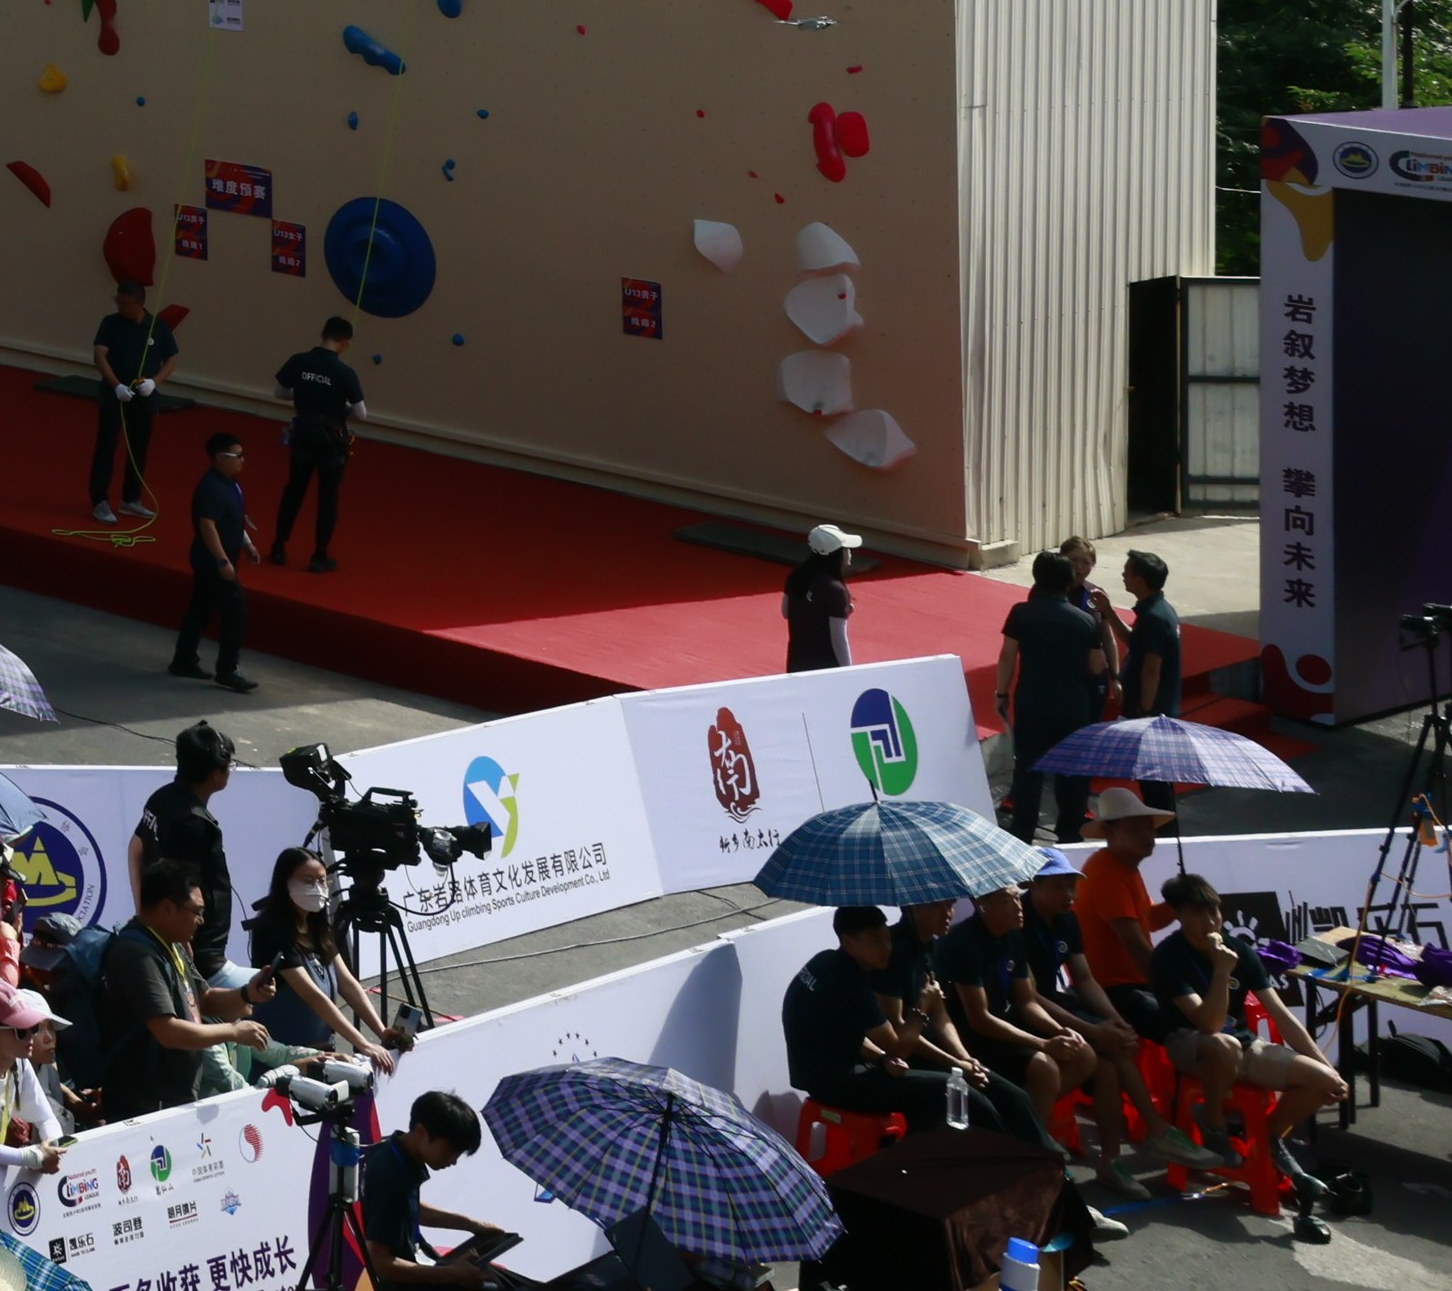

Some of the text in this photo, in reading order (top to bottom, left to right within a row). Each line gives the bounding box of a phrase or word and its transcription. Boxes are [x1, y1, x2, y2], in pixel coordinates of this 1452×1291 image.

[212, 178, 266, 201] 难度预赛
[273, 229, 304, 242] U13女子
[624, 289, 658, 302] U13男子
[301, 371, 332, 387] OFFICIAL
[1281, 292, 1317, 610] 岩叙梦想 攀向未来
[402, 842, 608, 917] 广东岩路体育文化发展有限公司
[407, 912, 450, 933] Guangdong
[450, 910, 462, 924] Up
[462, 901, 492, 919] climbing
[492, 895, 515, 912] Sports
[516, 889, 541, 905] Culture
[541, 879, 585, 898] Development
[167, 1201, 197, 1219] 明月镜片
[112, 1216, 143, 1237] 波司登
[69, 1232, 94, 1252] 凯乐石
[206, 1234, 297, 1291] 更快成长
